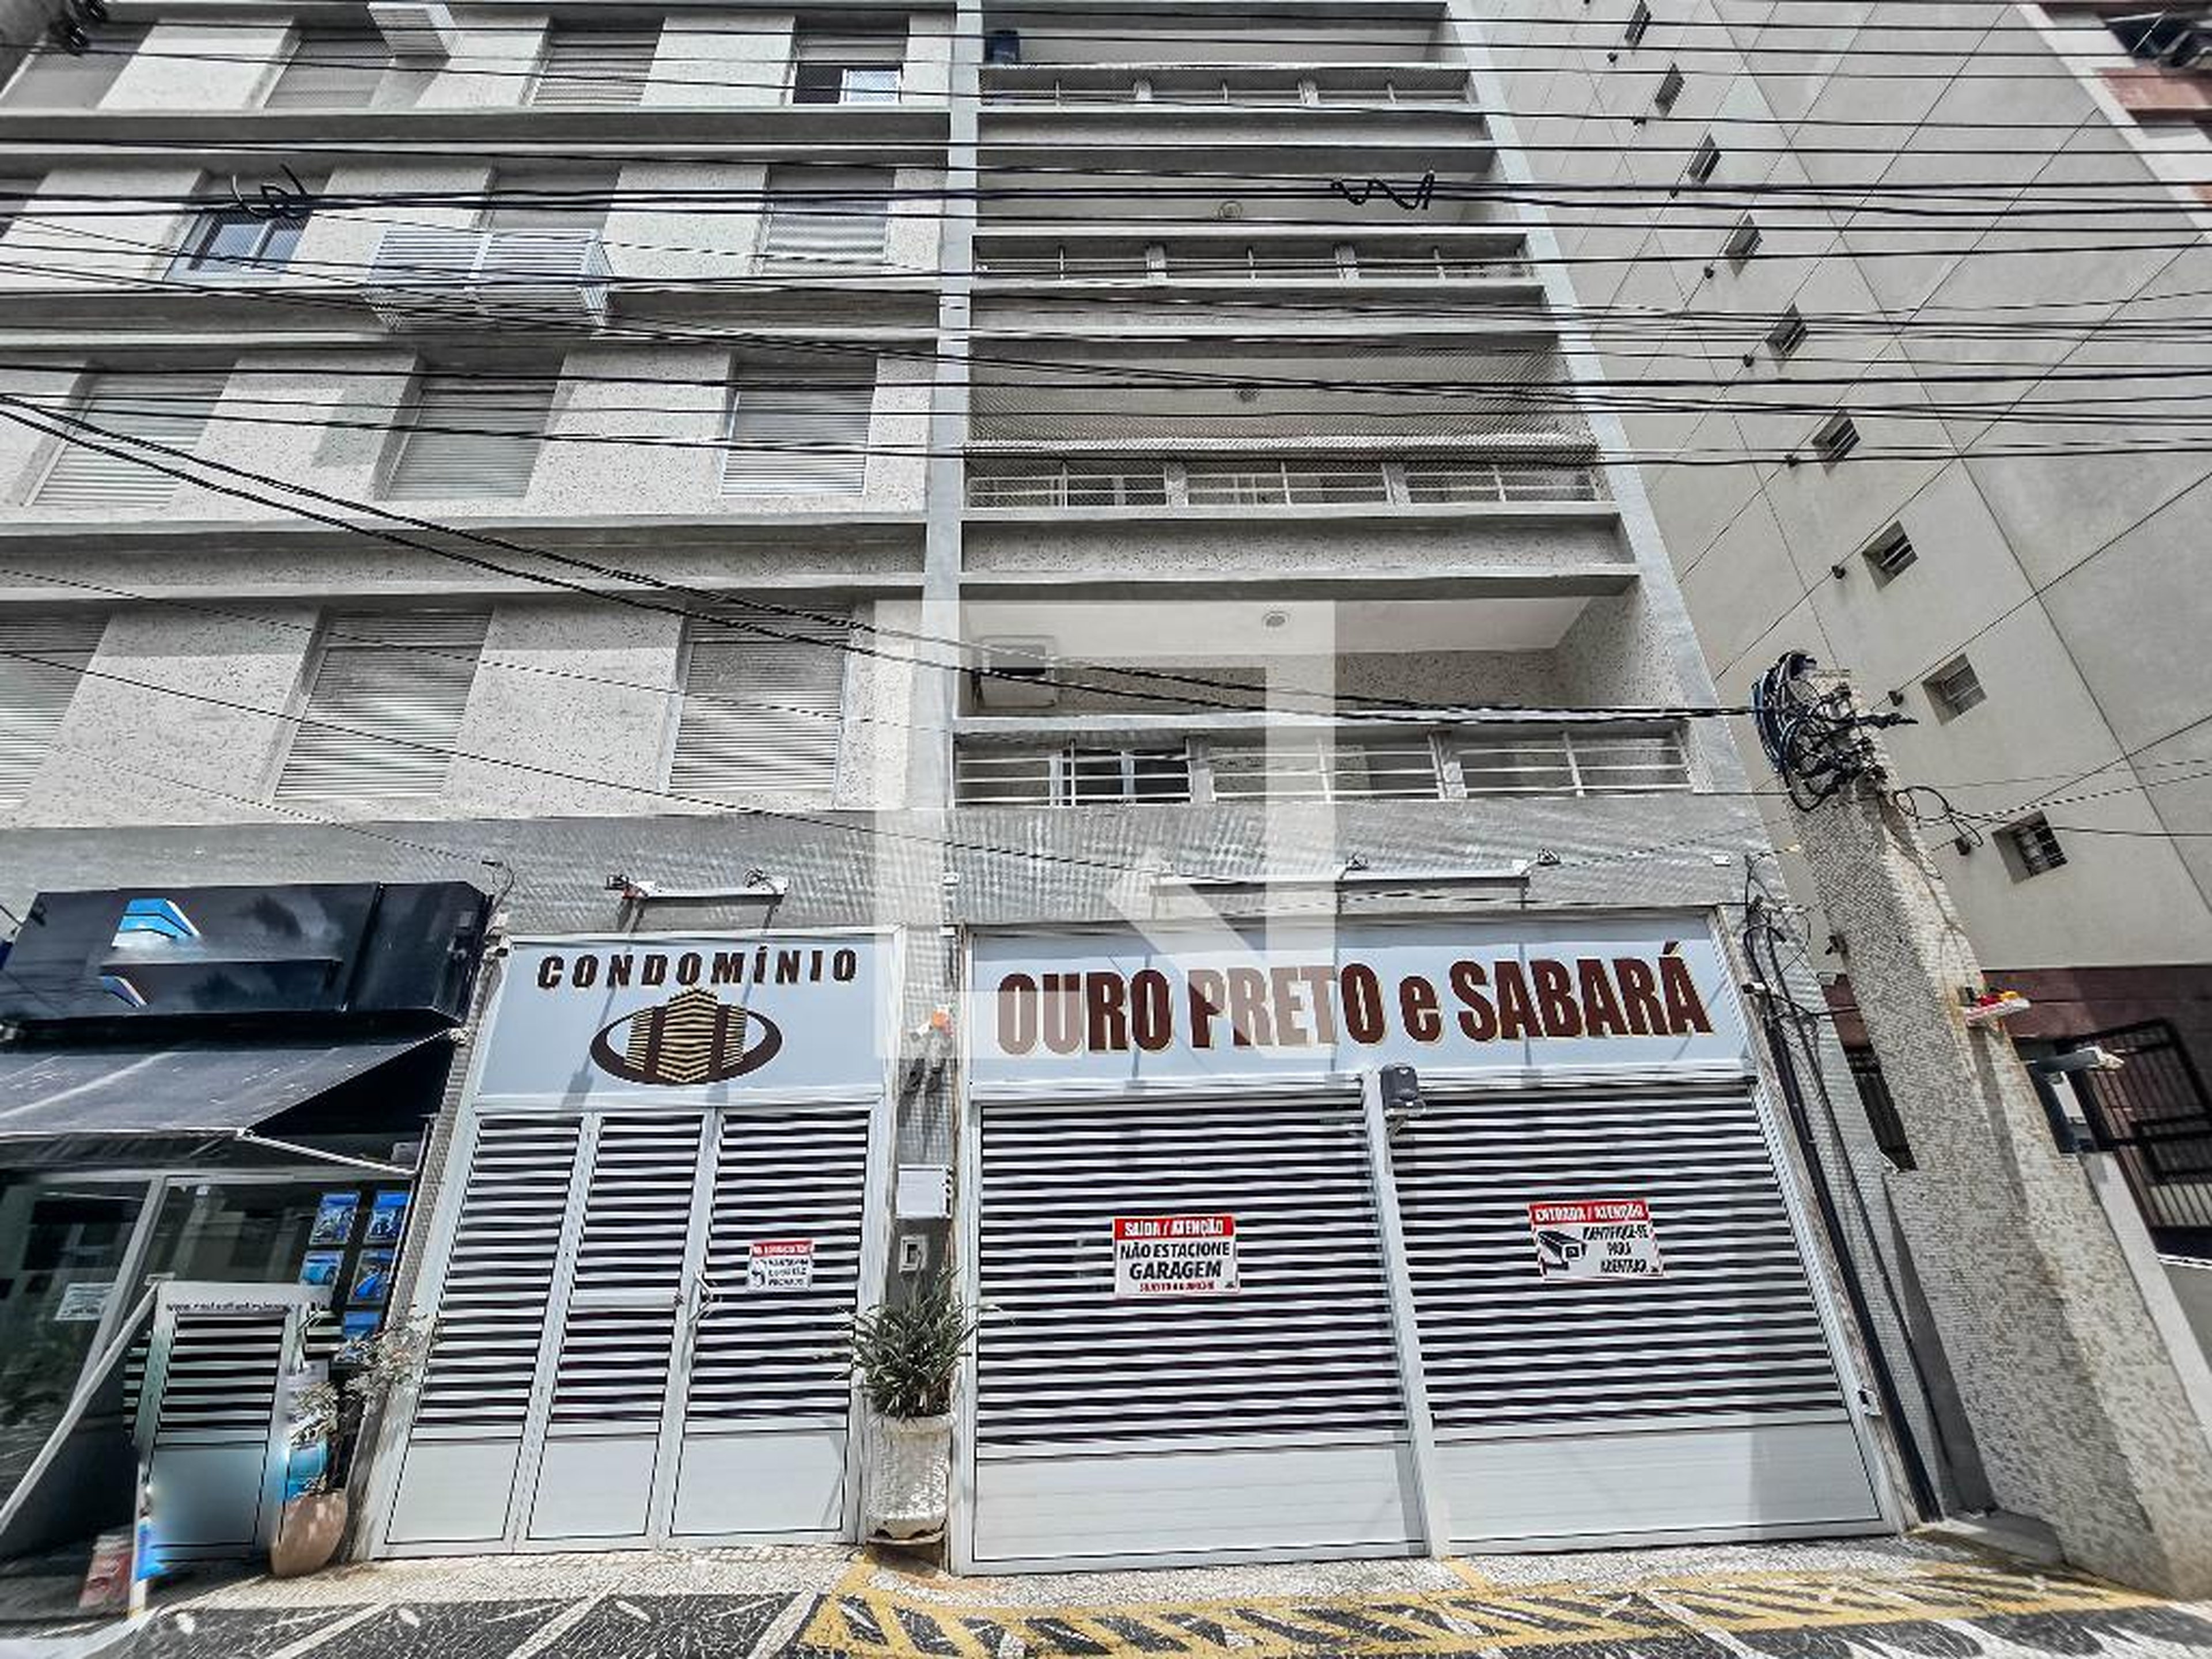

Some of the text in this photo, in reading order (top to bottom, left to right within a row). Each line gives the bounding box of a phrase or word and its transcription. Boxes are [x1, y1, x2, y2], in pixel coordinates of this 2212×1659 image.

[537, 945, 857, 989] CONDOMÍNIO
[997, 941, 1714, 1055] OURO PRETO e SABARÁ
[1124, 1220, 1161, 1237] SAÍDA
[1171, 1217, 1224, 1237] ATENÇÃO
[1120, 1241, 1230, 1259] NÃO ESTACIONE
[1129, 1260, 1222, 1280] GARAGEM
